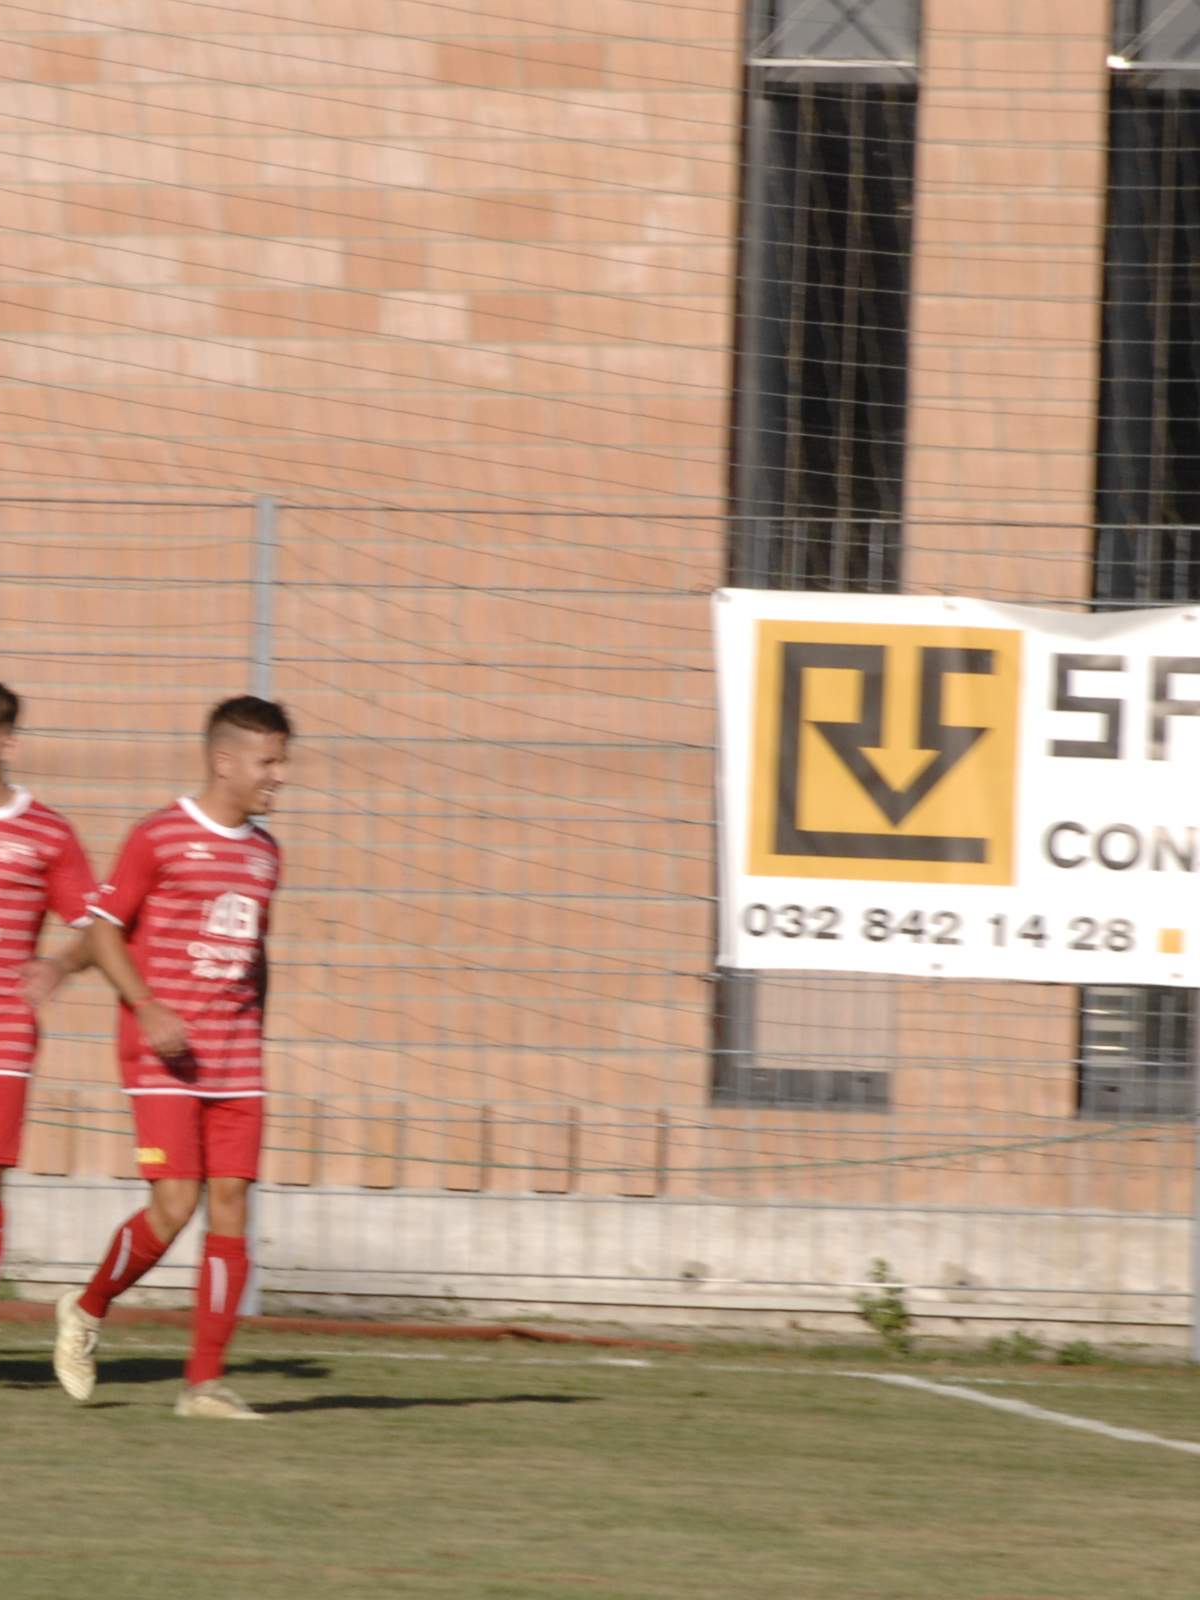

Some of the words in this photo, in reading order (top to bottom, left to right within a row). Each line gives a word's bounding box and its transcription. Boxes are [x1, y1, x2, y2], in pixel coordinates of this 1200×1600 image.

[1041, 820, 1200, 872] CON
[741, 902, 842, 940] 032
[860, 907, 961, 945] 842
[987, 913, 1049, 948] 14
[1067, 916, 1135, 952] 28
